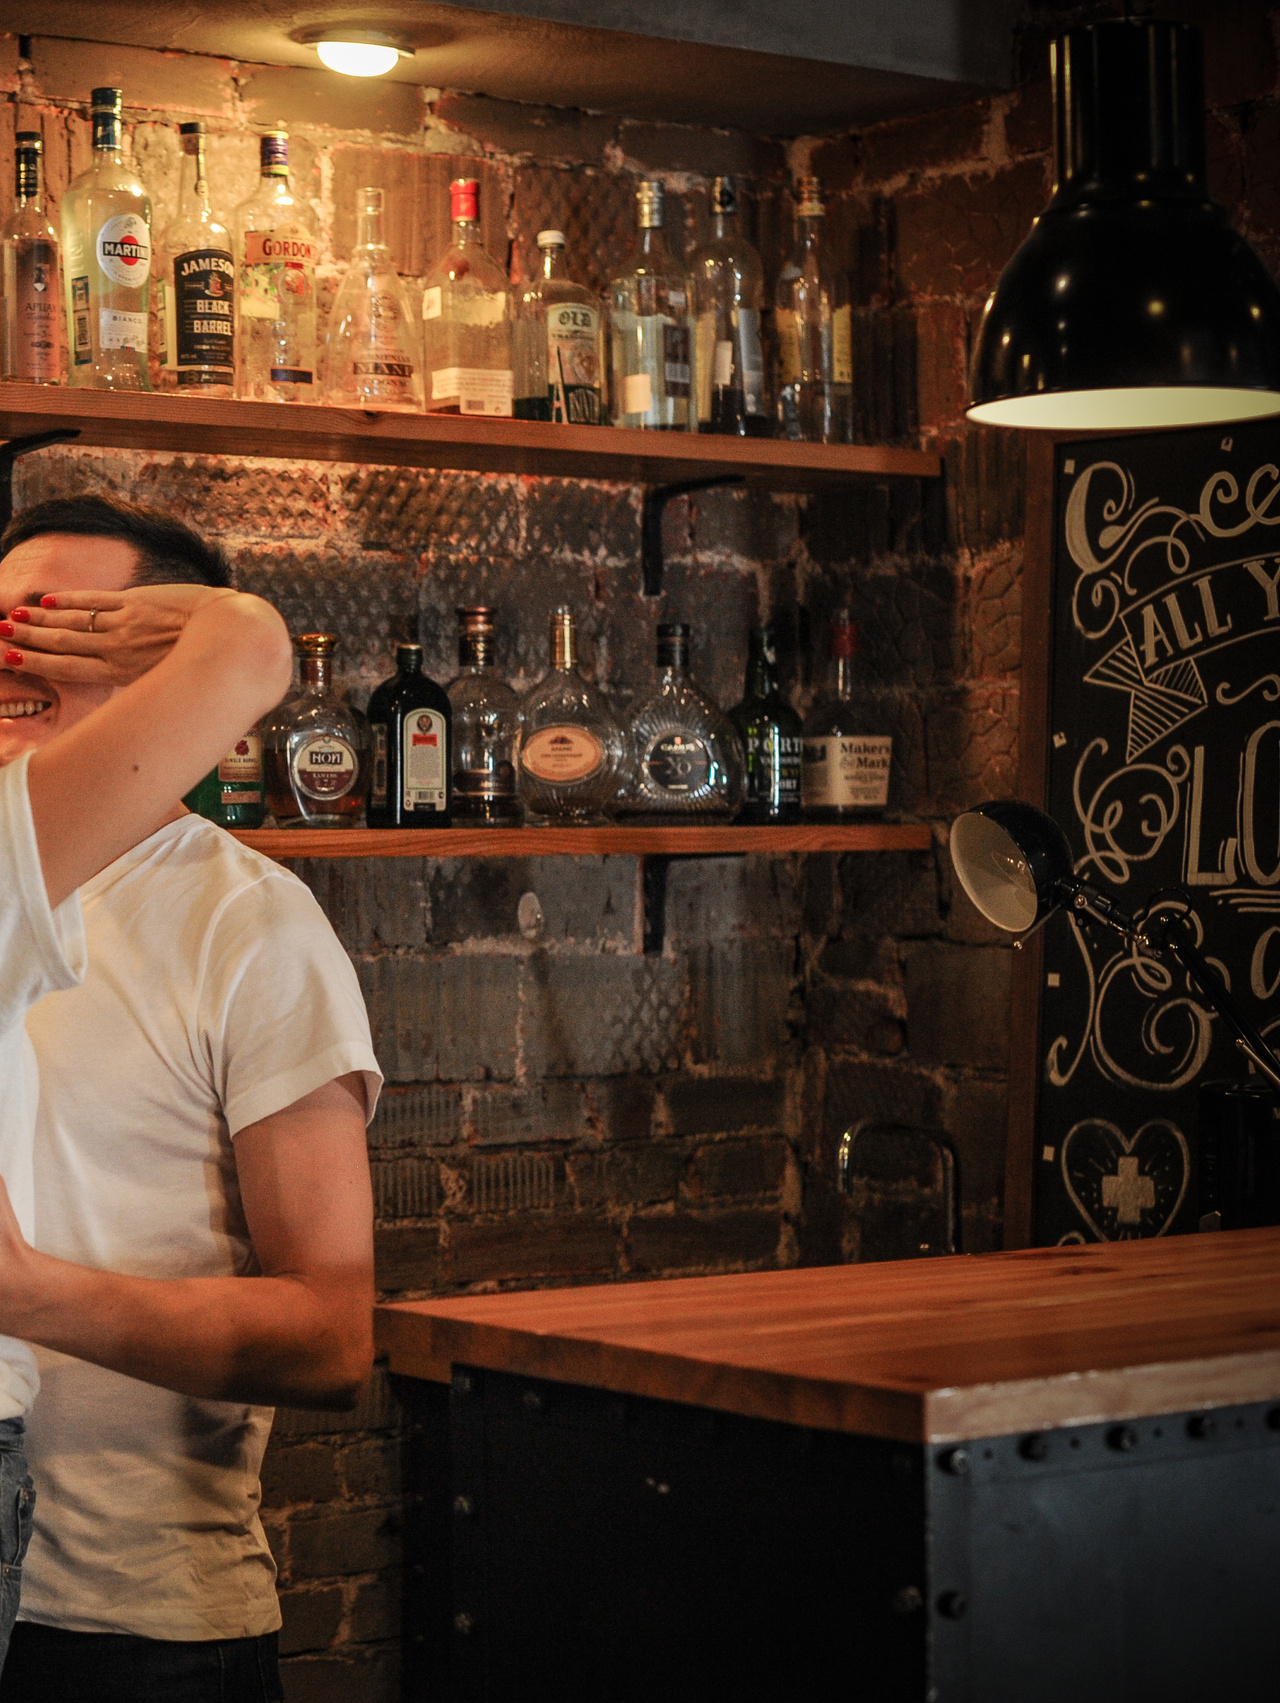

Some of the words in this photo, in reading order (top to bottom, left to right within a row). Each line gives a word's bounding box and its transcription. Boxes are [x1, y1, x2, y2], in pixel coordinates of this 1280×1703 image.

[180, 257, 234, 279] JAMESON
[196, 299, 231, 314] BLACK
[193, 319, 233, 336] BARREL
[1138, 575, 1232, 668] ALL
